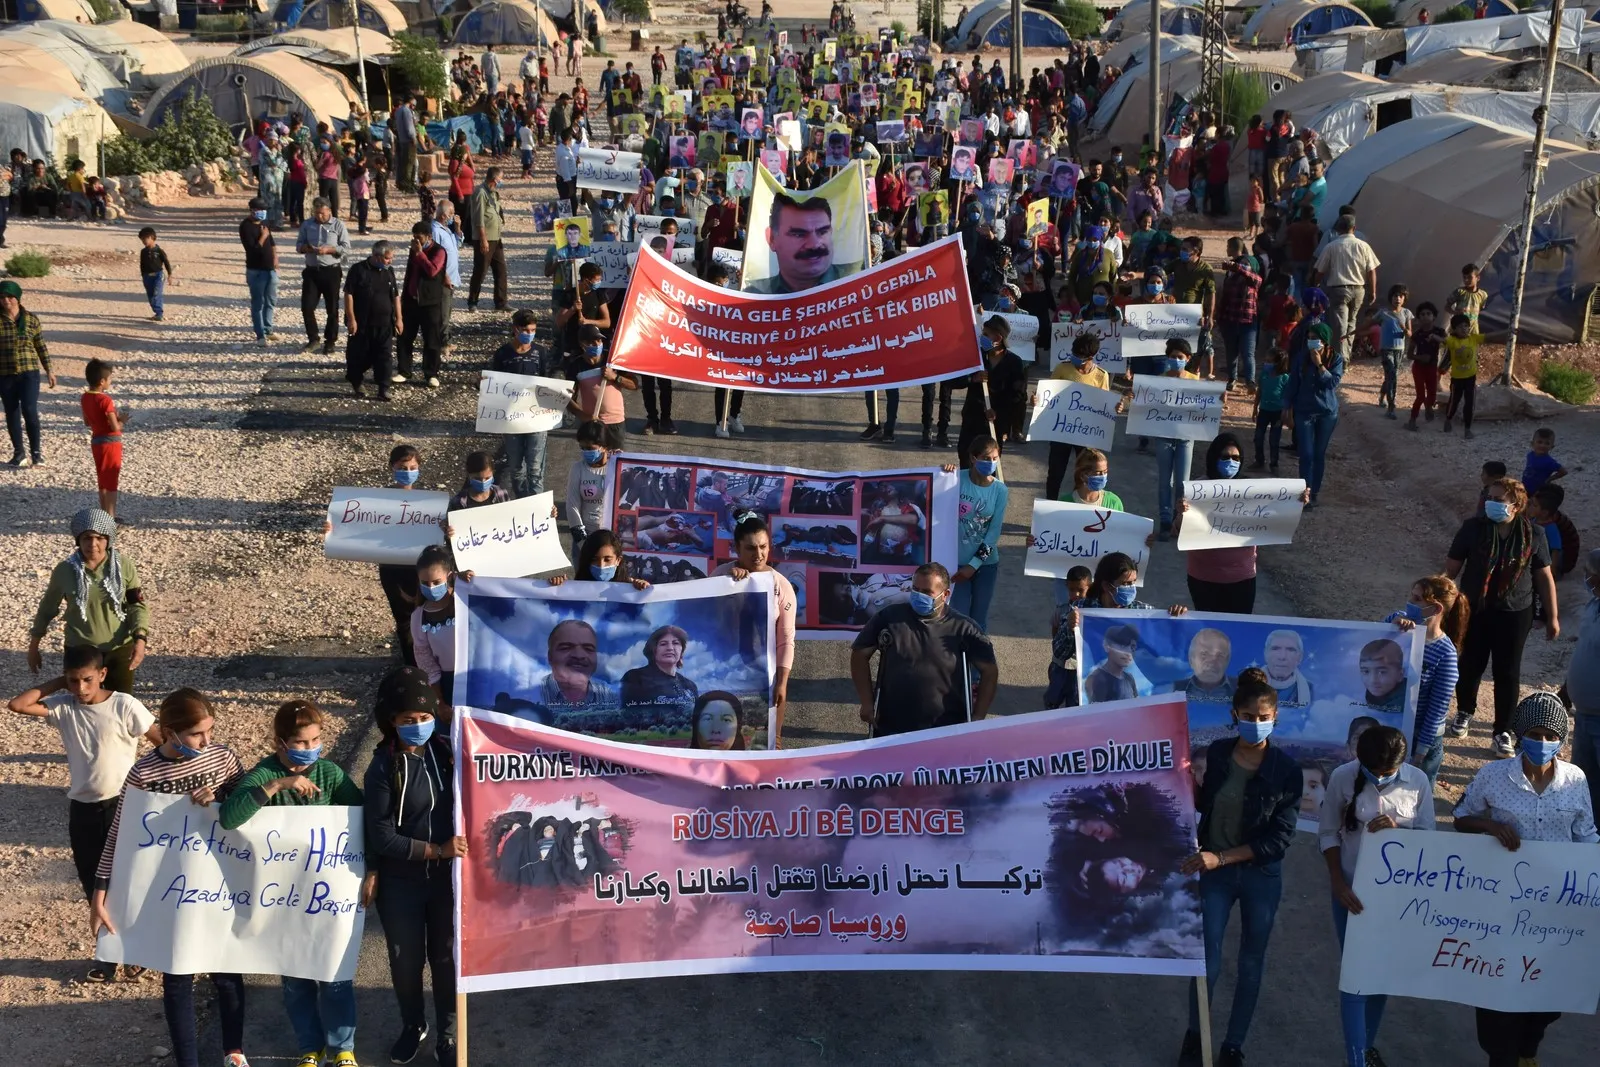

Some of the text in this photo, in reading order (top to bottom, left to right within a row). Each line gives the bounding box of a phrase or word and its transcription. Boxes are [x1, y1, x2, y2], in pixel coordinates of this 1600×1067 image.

[748, 307, 792, 322] GELÊ
[796, 291, 858, 322] ŞERKER
[861, 285, 874, 300] Û
[878, 265, 937, 295] GERÎLA
[667, 311, 780, 345] DAGIRKERIYÊ
[784, 328, 796, 341] Û
[876, 300, 908, 321] TÊK
[912, 287, 957, 312] BIBIN
[660, 334, 703, 359] الكريلا
[822, 334, 881, 361] الشعبية
[885, 324, 934, 349] بالحرب
[766, 346, 818, 367] الثورية
[707, 367, 765, 384] والخيانة
[830, 364, 884, 384] سندحر
[1191, 483, 1206, 500] Bi
[341, 500, 391, 525] Bimire
[1083, 509, 1111, 532] لا
[492, 516, 529, 544] مقاومة
[1060, 535, 1098, 557] الدولة
[1050, 749, 1090, 776] ME
[784, 805, 810, 838] JÎ
[815, 803, 853, 837] BÊ
[860, 808, 965, 837] DENGE
[138, 811, 251, 862] Serkeftina
[676, 866, 759, 896] أطفالنا
[765, 864, 817, 898] تقتل
[822, 863, 889, 897] أرضنا
[896, 862, 950, 897] تحتل
[1375, 841, 1500, 894] Serkeftina
[161, 874, 251, 911] Azadiya
[594, 871, 672, 905] وكبارنا
[745, 907, 909, 942] وروسيا صامتة
[1400, 898, 1501, 941] Misogeriya
[1520, 955, 1541, 983] Ye
